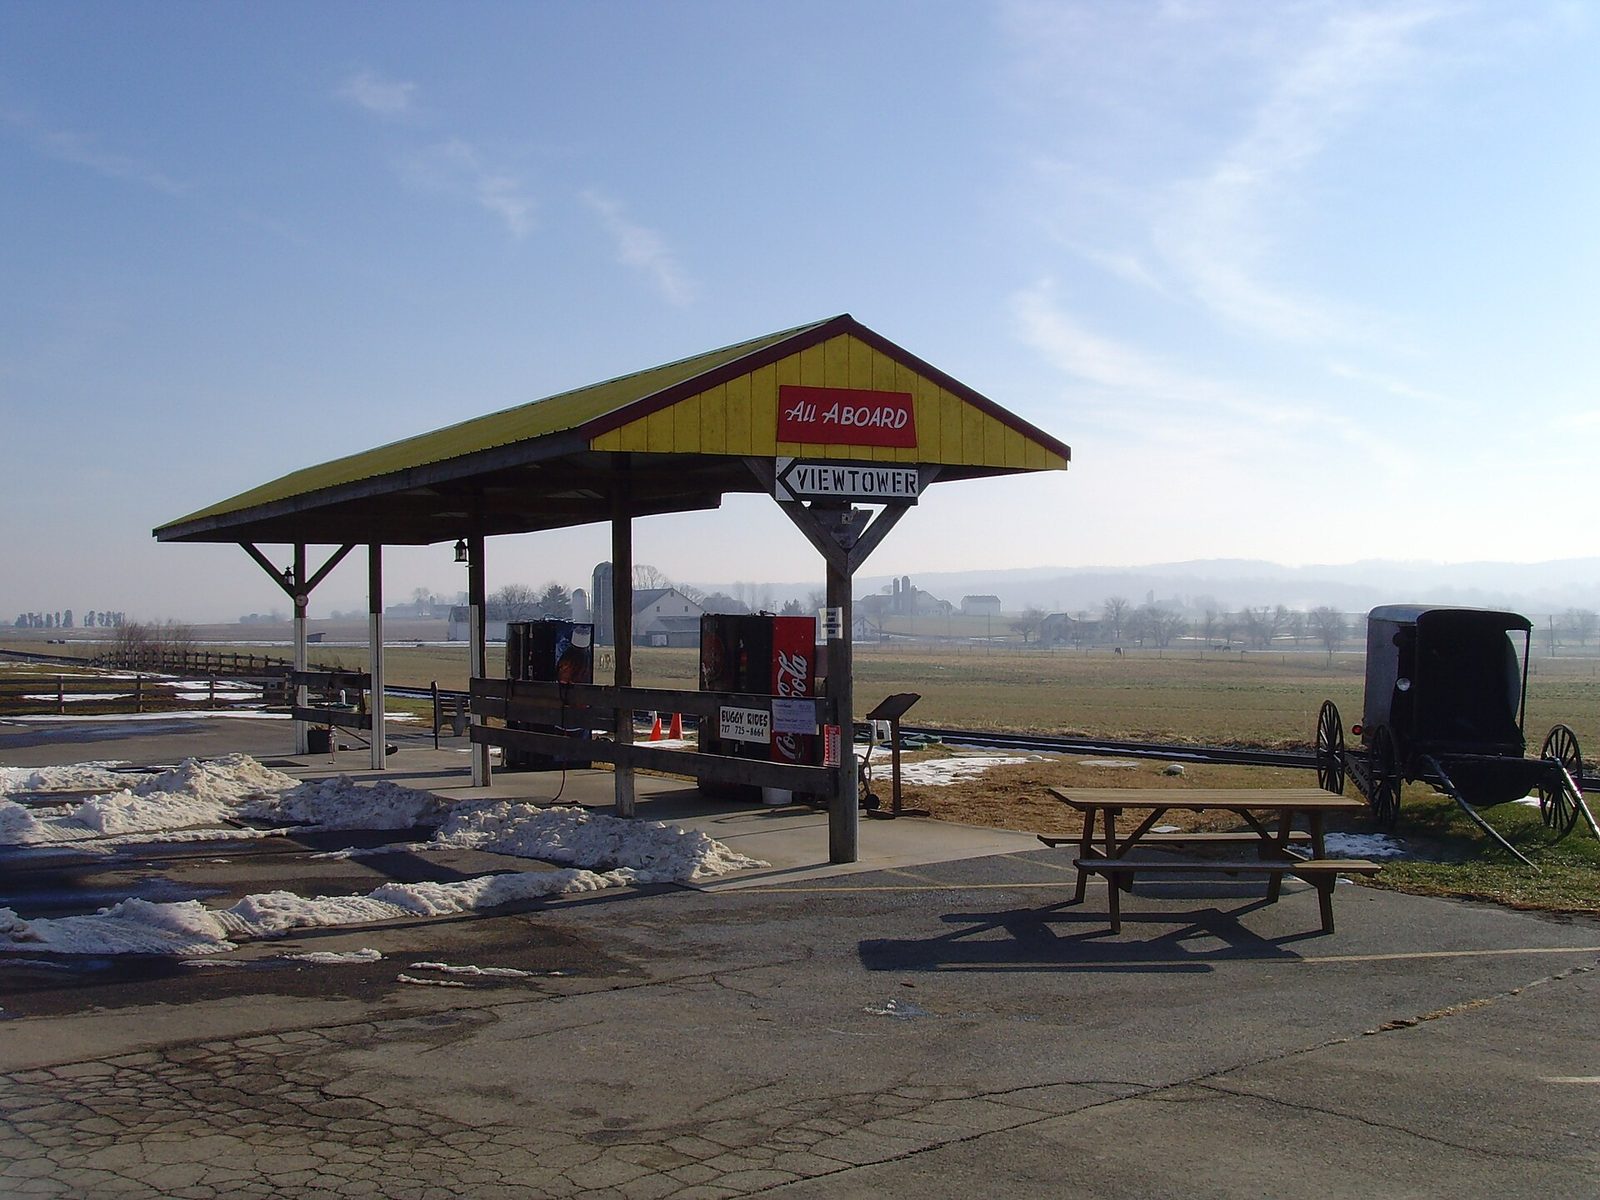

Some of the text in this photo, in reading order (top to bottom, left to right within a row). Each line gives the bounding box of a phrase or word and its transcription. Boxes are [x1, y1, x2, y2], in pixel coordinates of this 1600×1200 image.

[822, 402, 908, 429] ABOARD
[797, 469, 916, 494] VIEWTOWER
[721, 710, 744, 724] BUGGY
[747, 713, 768, 727] RIDES
[721, 724, 730, 733] 717
